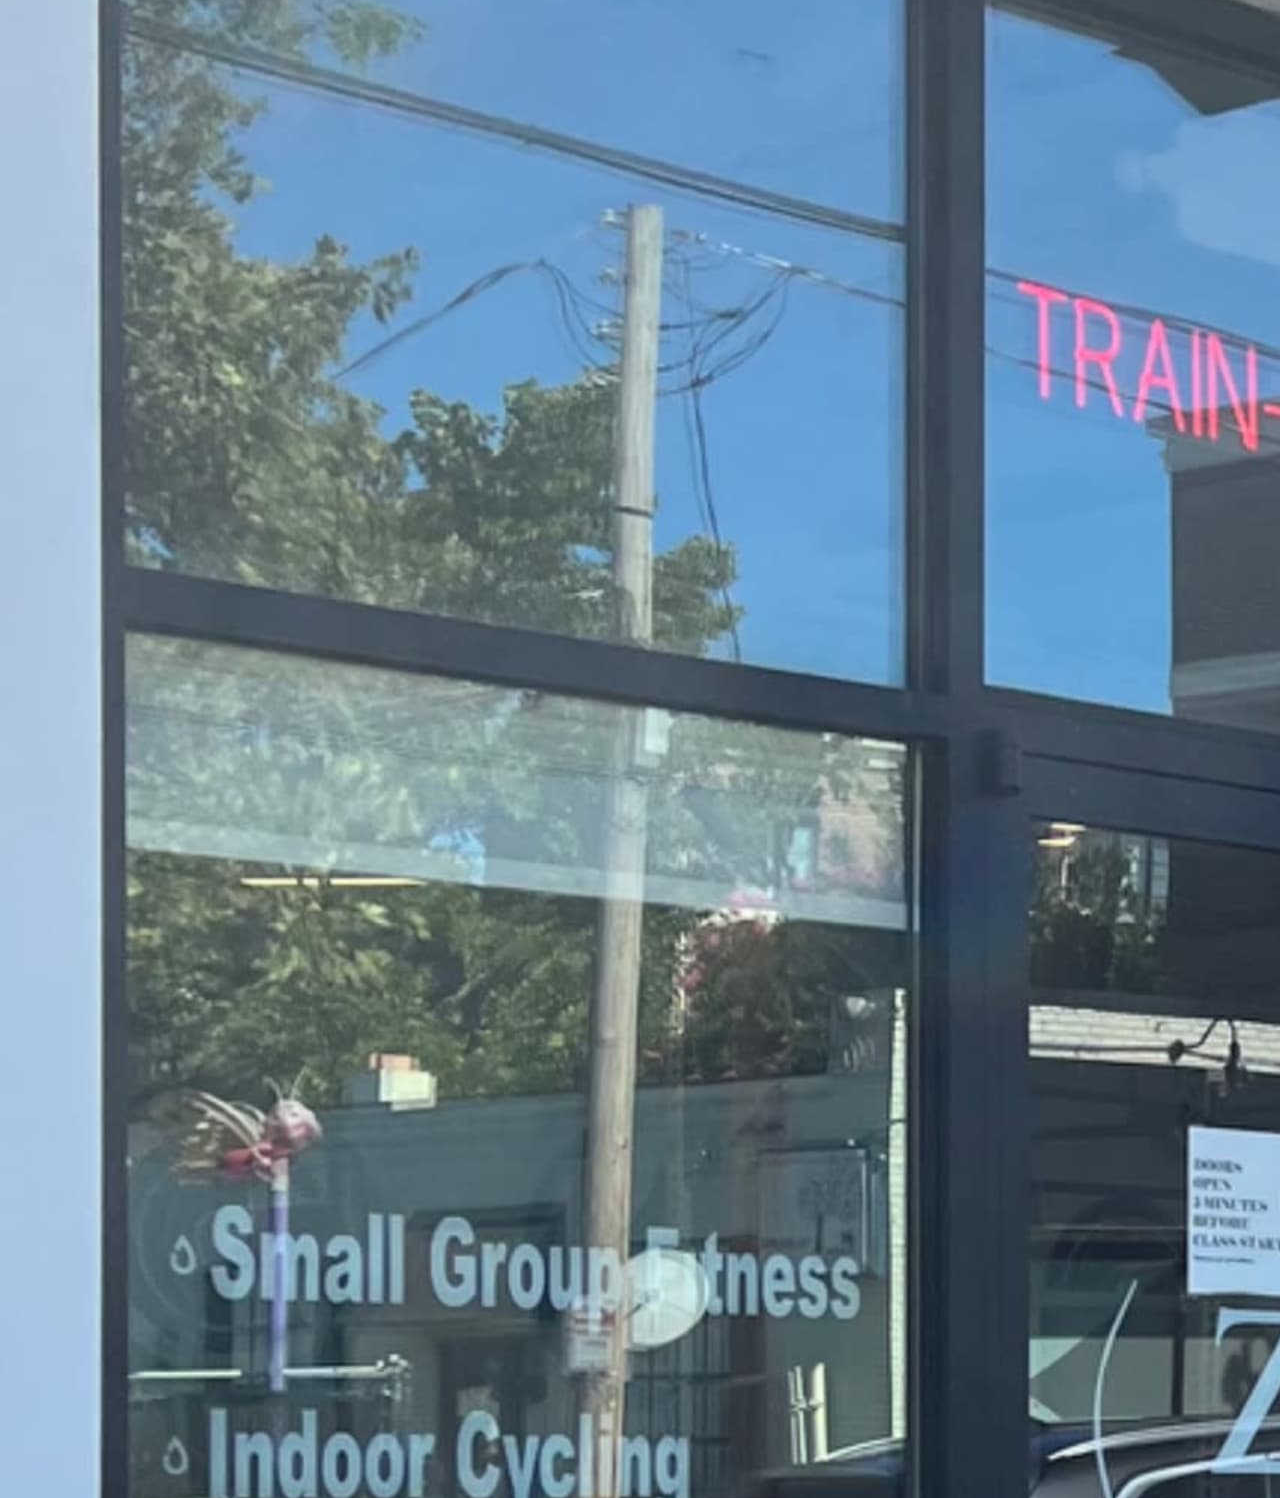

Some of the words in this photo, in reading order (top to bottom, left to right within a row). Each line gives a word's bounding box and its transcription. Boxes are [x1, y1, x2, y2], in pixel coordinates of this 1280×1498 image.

[1193, 1178, 1231, 1190] OPEN
[1203, 1197, 1268, 1211] MINUTES
[1193, 1235, 1238, 1248] CLASS
[211, 1205, 404, 1304] Small
[430, 1216, 622, 1334] Group
